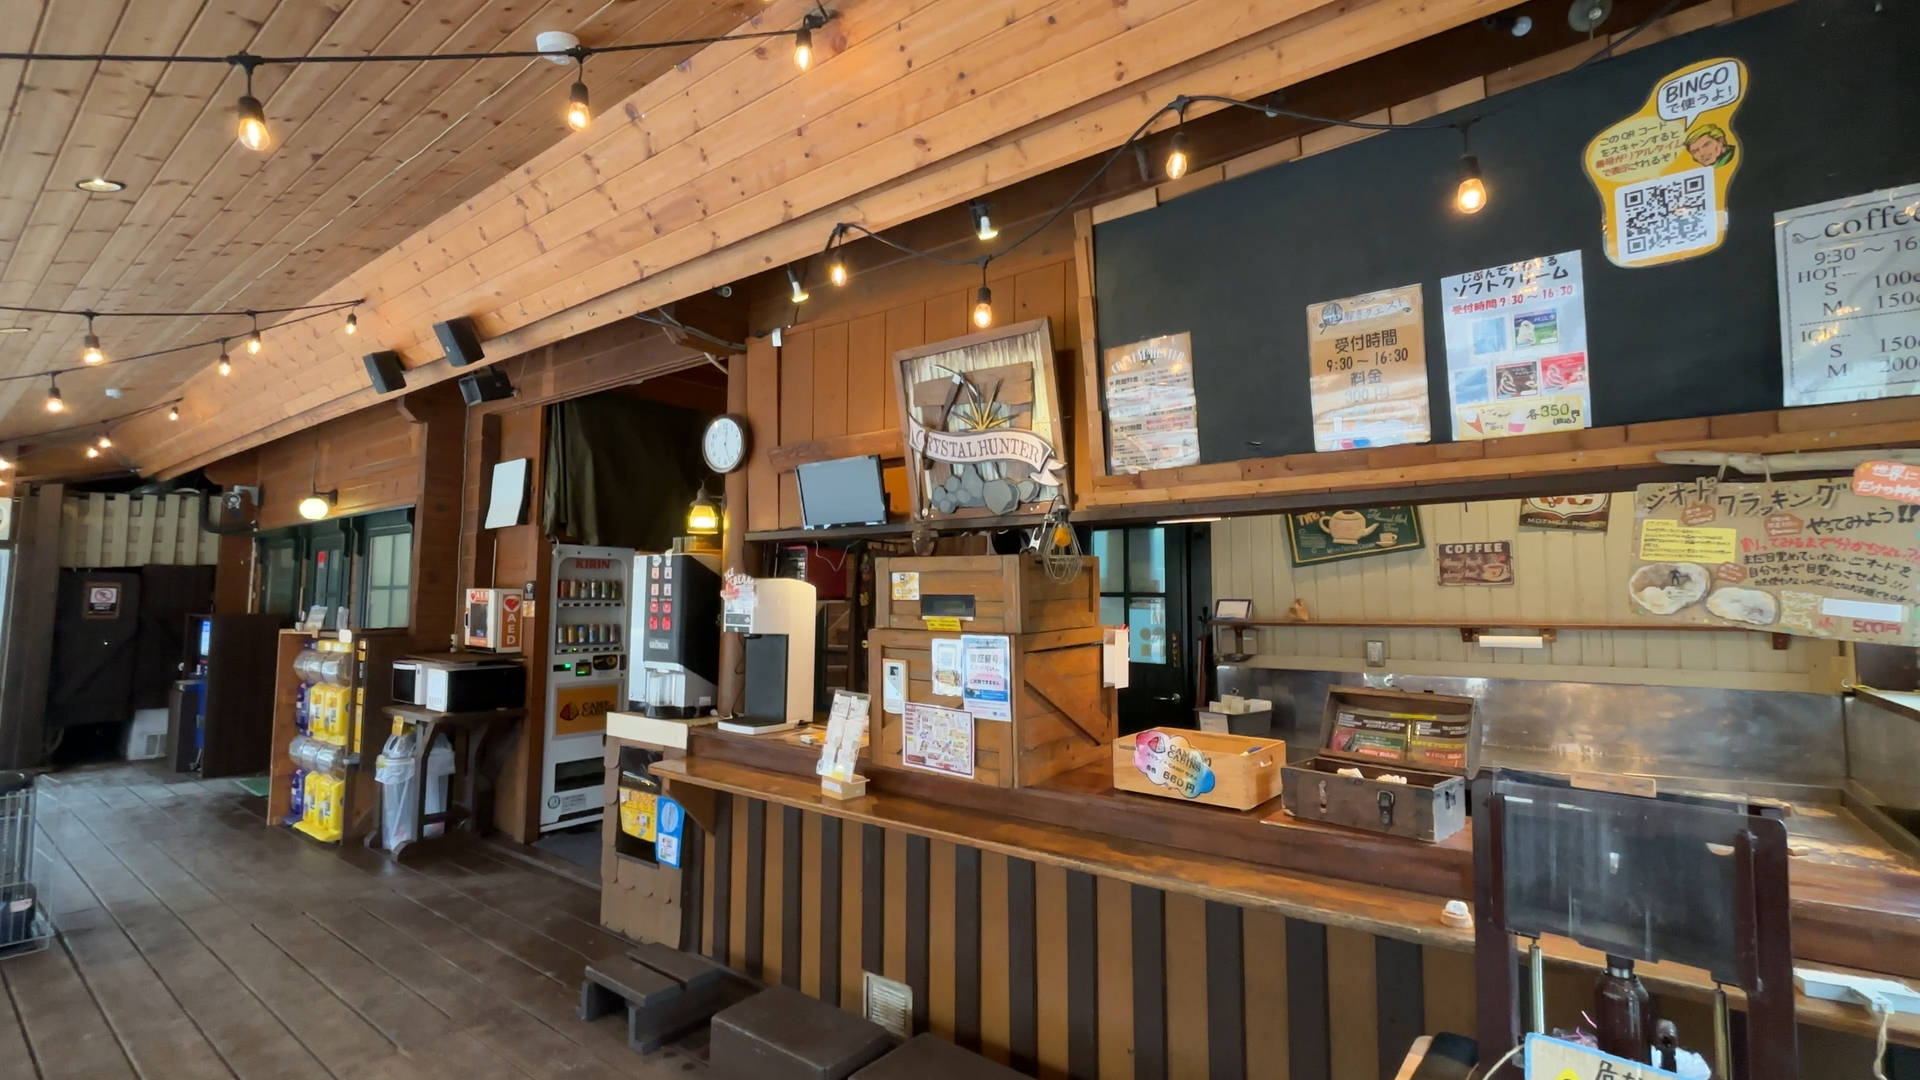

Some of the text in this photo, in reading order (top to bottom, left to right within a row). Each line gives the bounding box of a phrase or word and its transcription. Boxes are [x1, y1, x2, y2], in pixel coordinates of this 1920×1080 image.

[1666, 67, 1728, 103] BINGO
[1814, 247, 1856, 265] 9:30
[1453, 266, 1569, 297] ソフトクリーム
[1335, 328, 1398, 354] 受付時間
[1326, 356, 1353, 372] 9:30
[1375, 349, 1408, 366] 16:30
[1350, 368, 1382, 386] 料金
[978, 438, 1041, 463] HUNTER
[1445, 543, 1503, 554] COFFEE
[576, 559, 610, 569] KIRIN
[507, 613, 516, 645] AED
